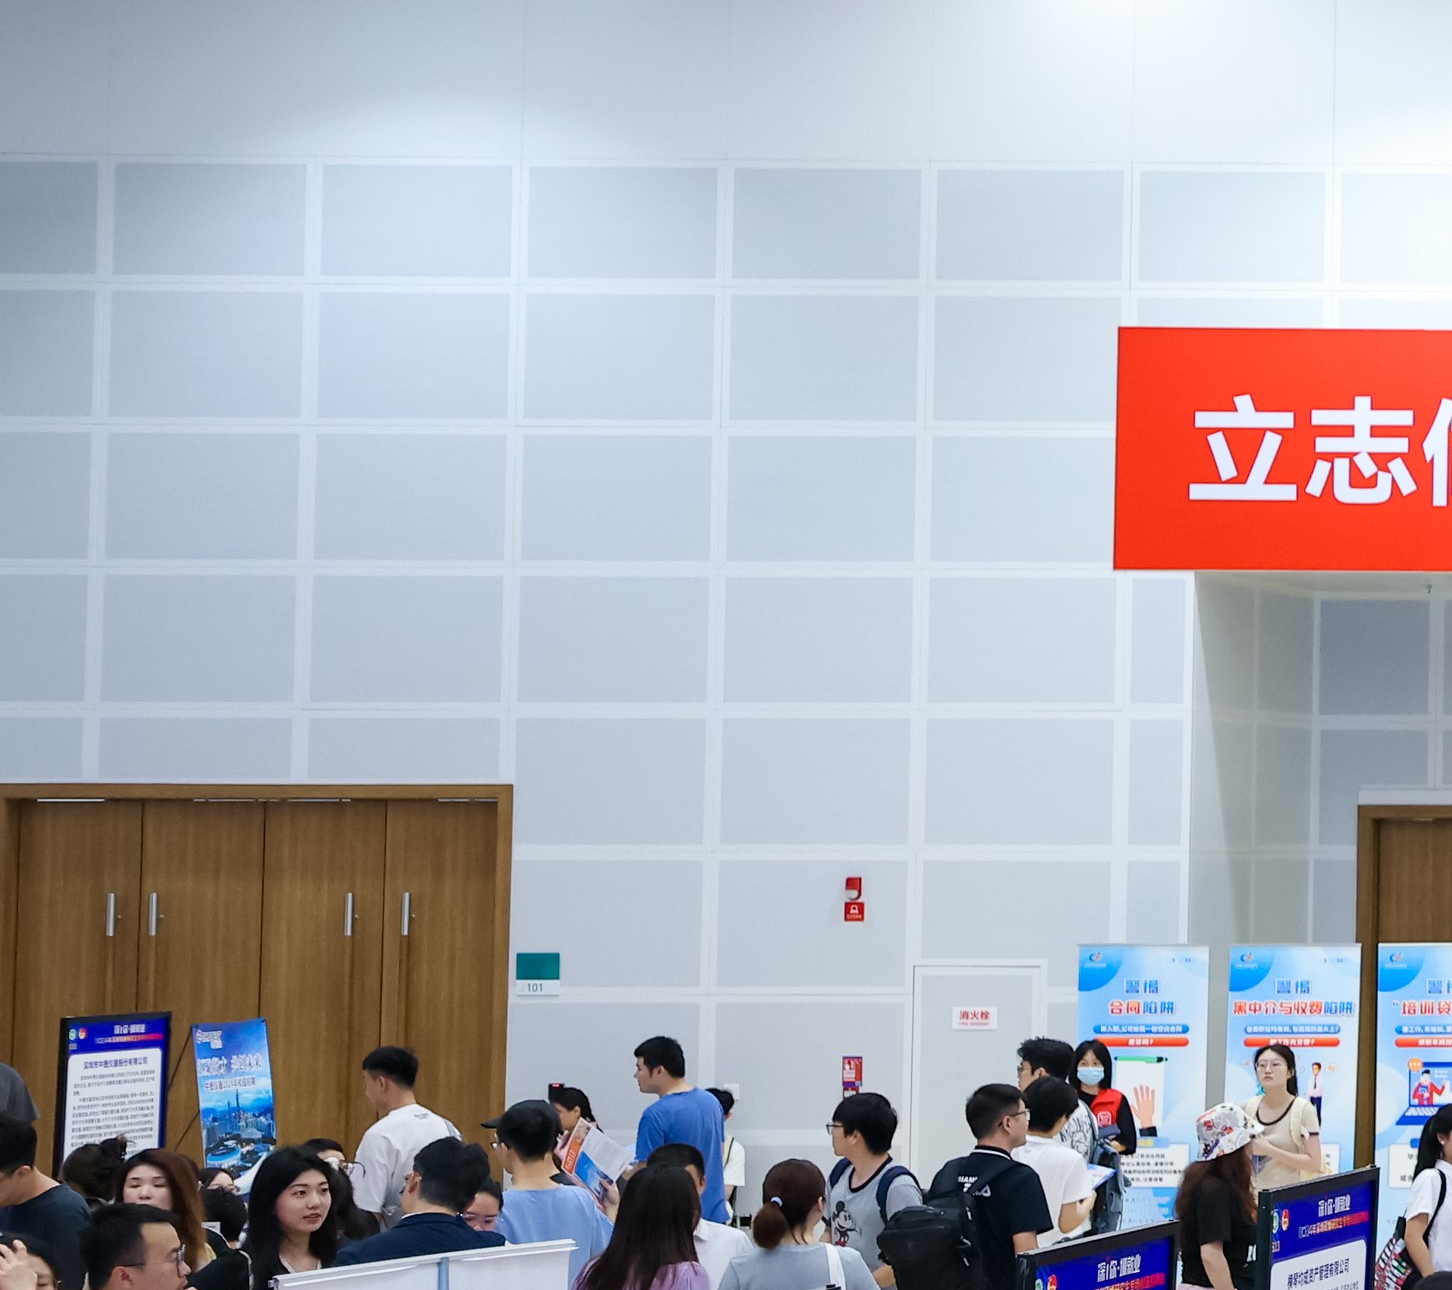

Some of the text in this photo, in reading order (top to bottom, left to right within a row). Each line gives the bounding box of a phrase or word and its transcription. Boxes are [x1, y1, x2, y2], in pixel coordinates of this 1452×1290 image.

[1109, 1000, 1176, 1015] 合同陷阱
[1233, 1000, 1355, 1016] 黑中介与收费陷阱
[959, 1010, 990, 1021] 消火栓
